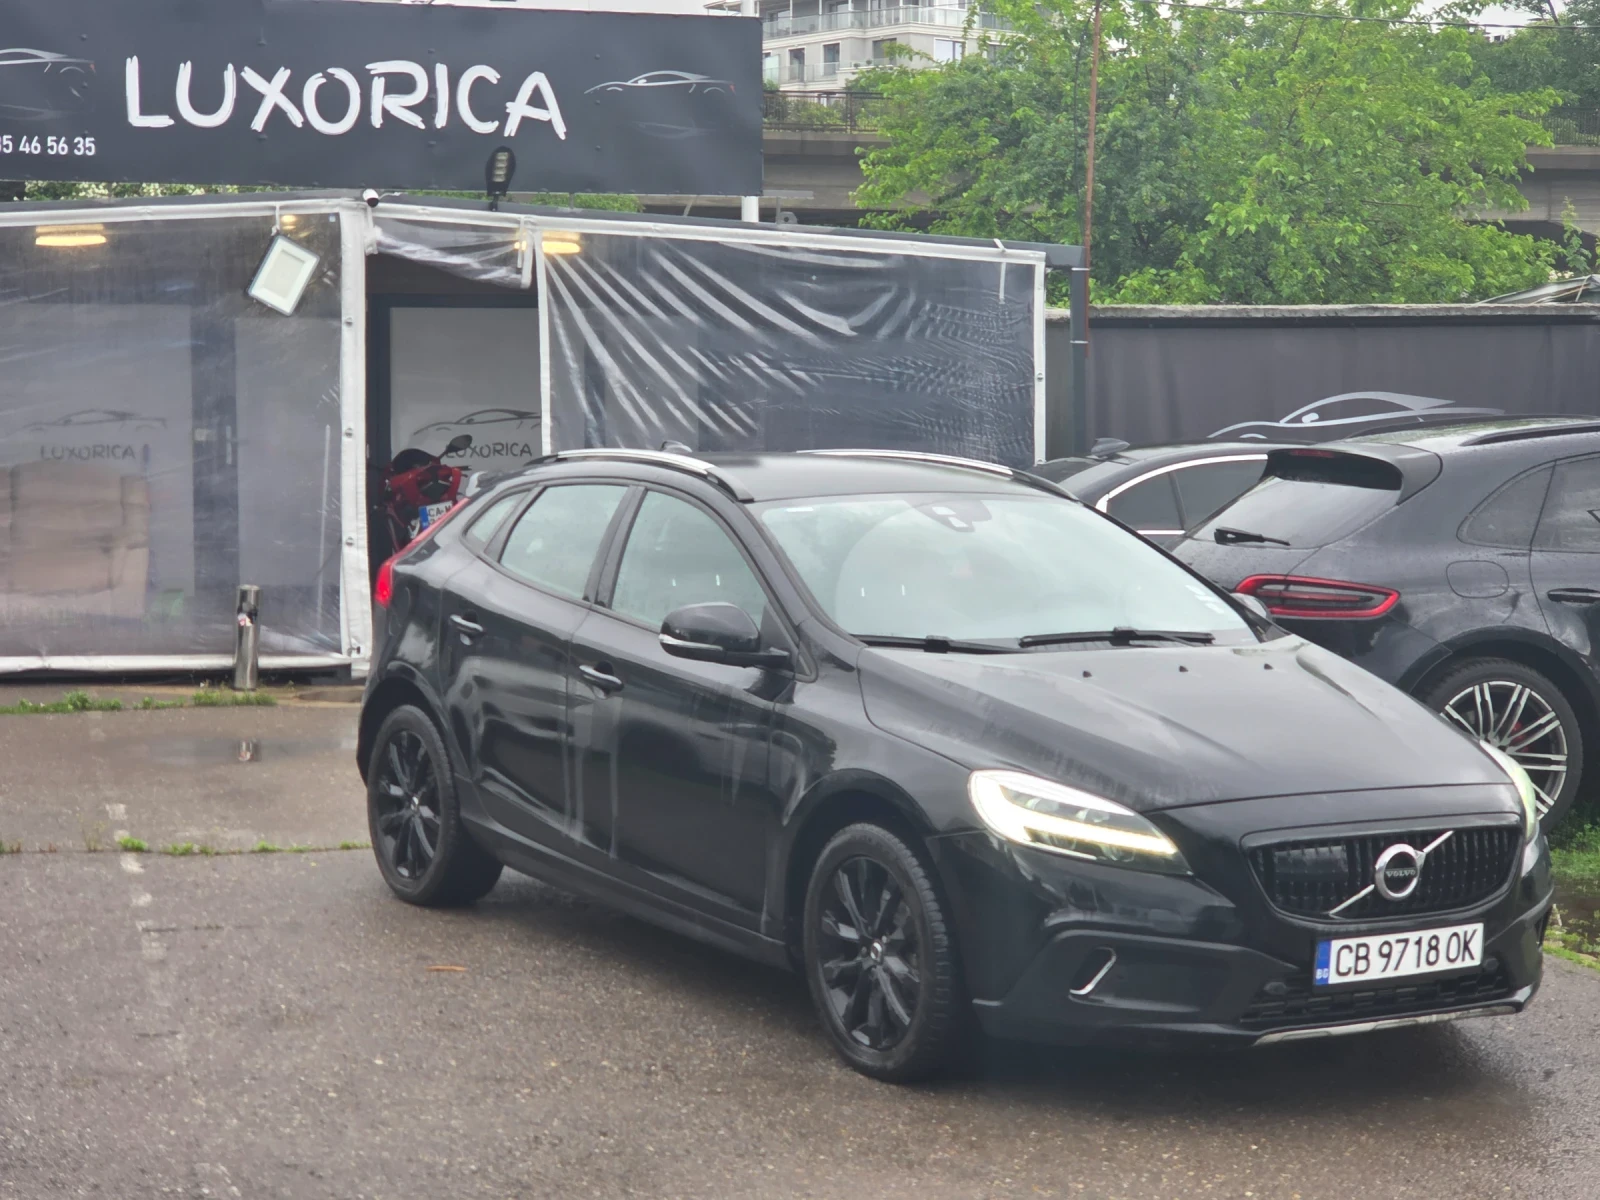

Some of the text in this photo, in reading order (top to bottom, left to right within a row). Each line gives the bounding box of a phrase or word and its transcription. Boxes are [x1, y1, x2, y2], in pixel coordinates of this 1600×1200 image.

[125, 55, 567, 140] LUXORICA
[0, 134, 96, 156] 5 46 56 35
[40, 444, 136, 460] LUXORICA
[1386, 869, 1416, 878] VOLVO
[1335, 928, 1478, 977] CB 9718 OK
[1316, 968, 1329, 979] BG
